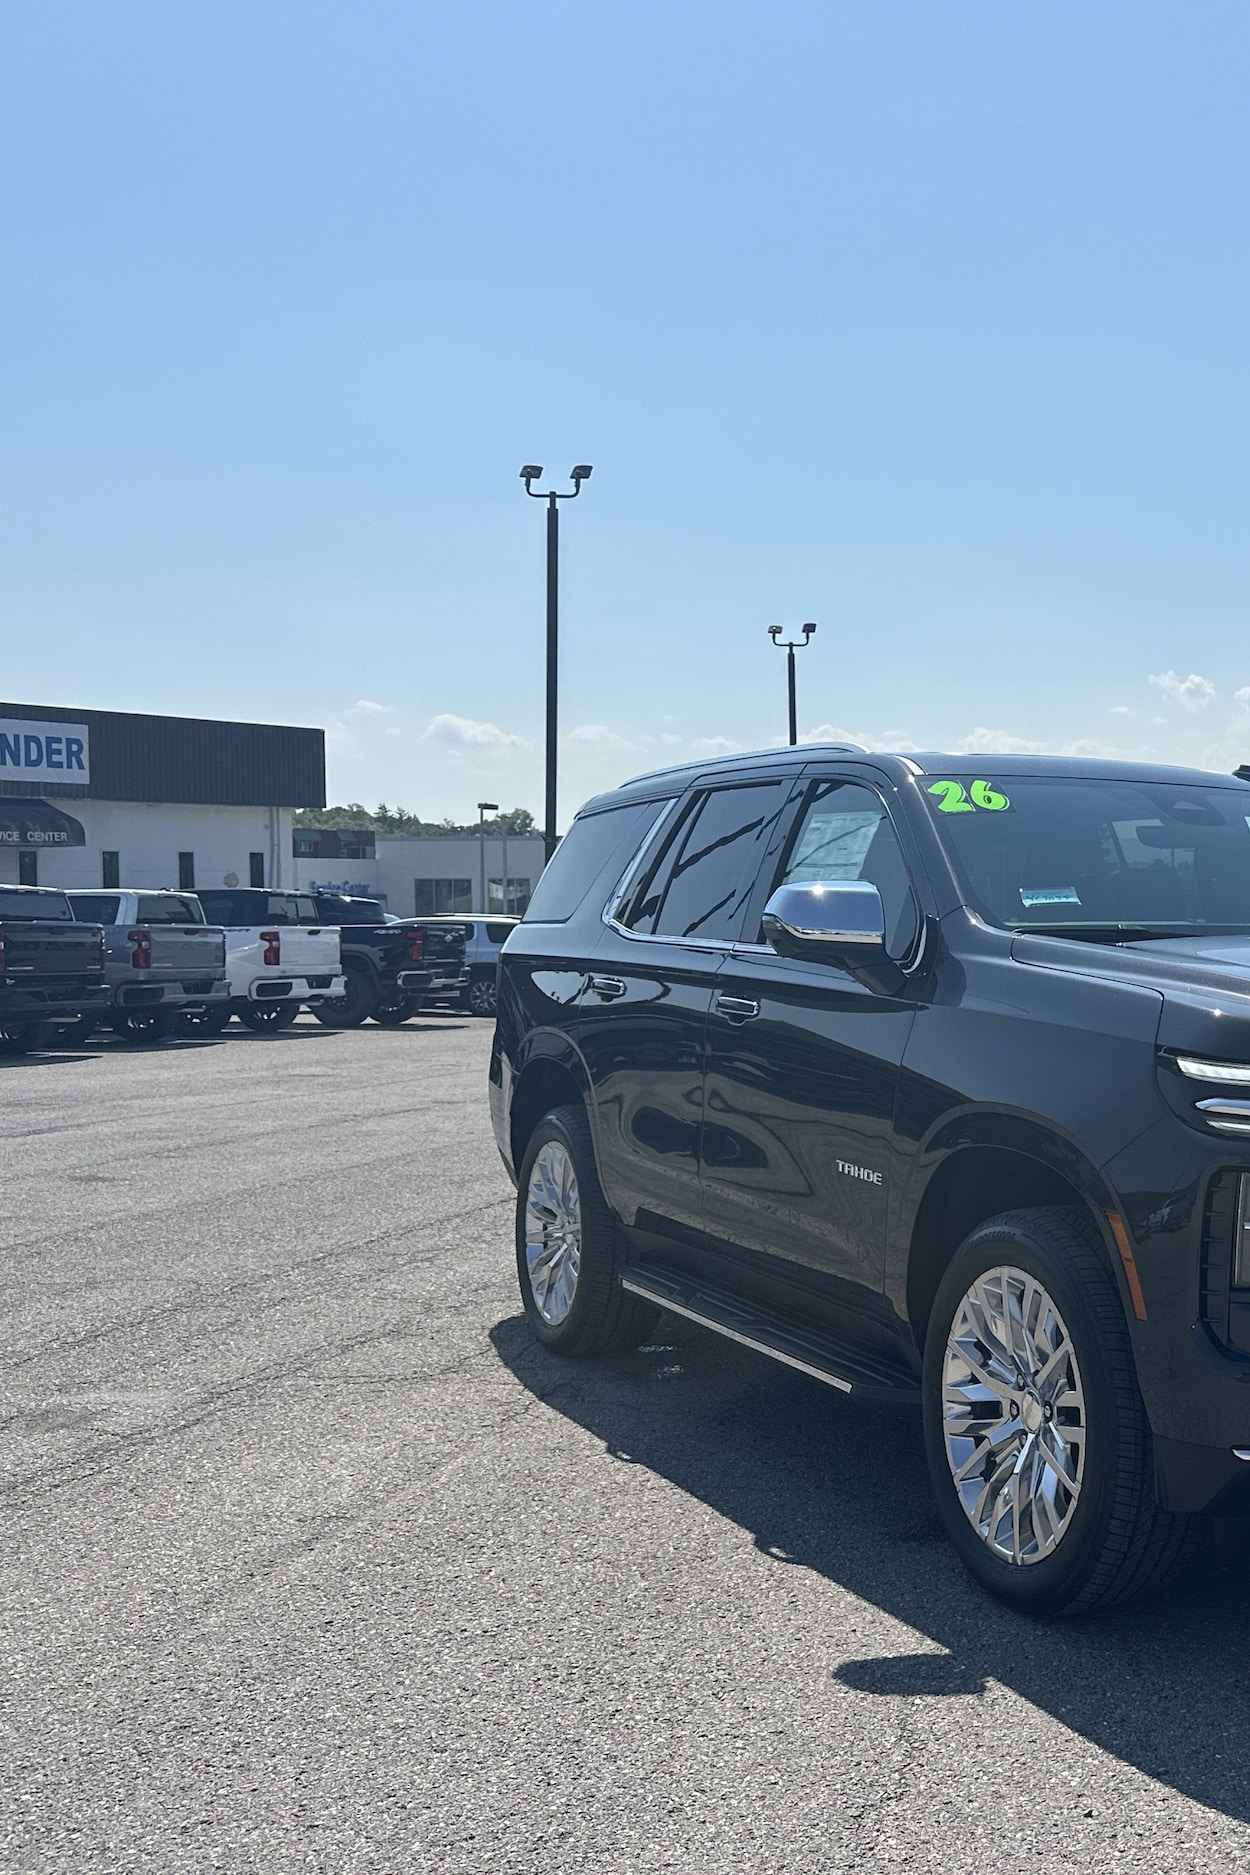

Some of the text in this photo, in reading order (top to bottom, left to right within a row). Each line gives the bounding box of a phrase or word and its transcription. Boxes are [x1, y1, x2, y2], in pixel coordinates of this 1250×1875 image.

[0, 733, 86, 770] NDER
[927, 779, 1011, 813] 26
[27, 831, 68, 842] CENTER
[835, 1159, 883, 1186] TAHOE
